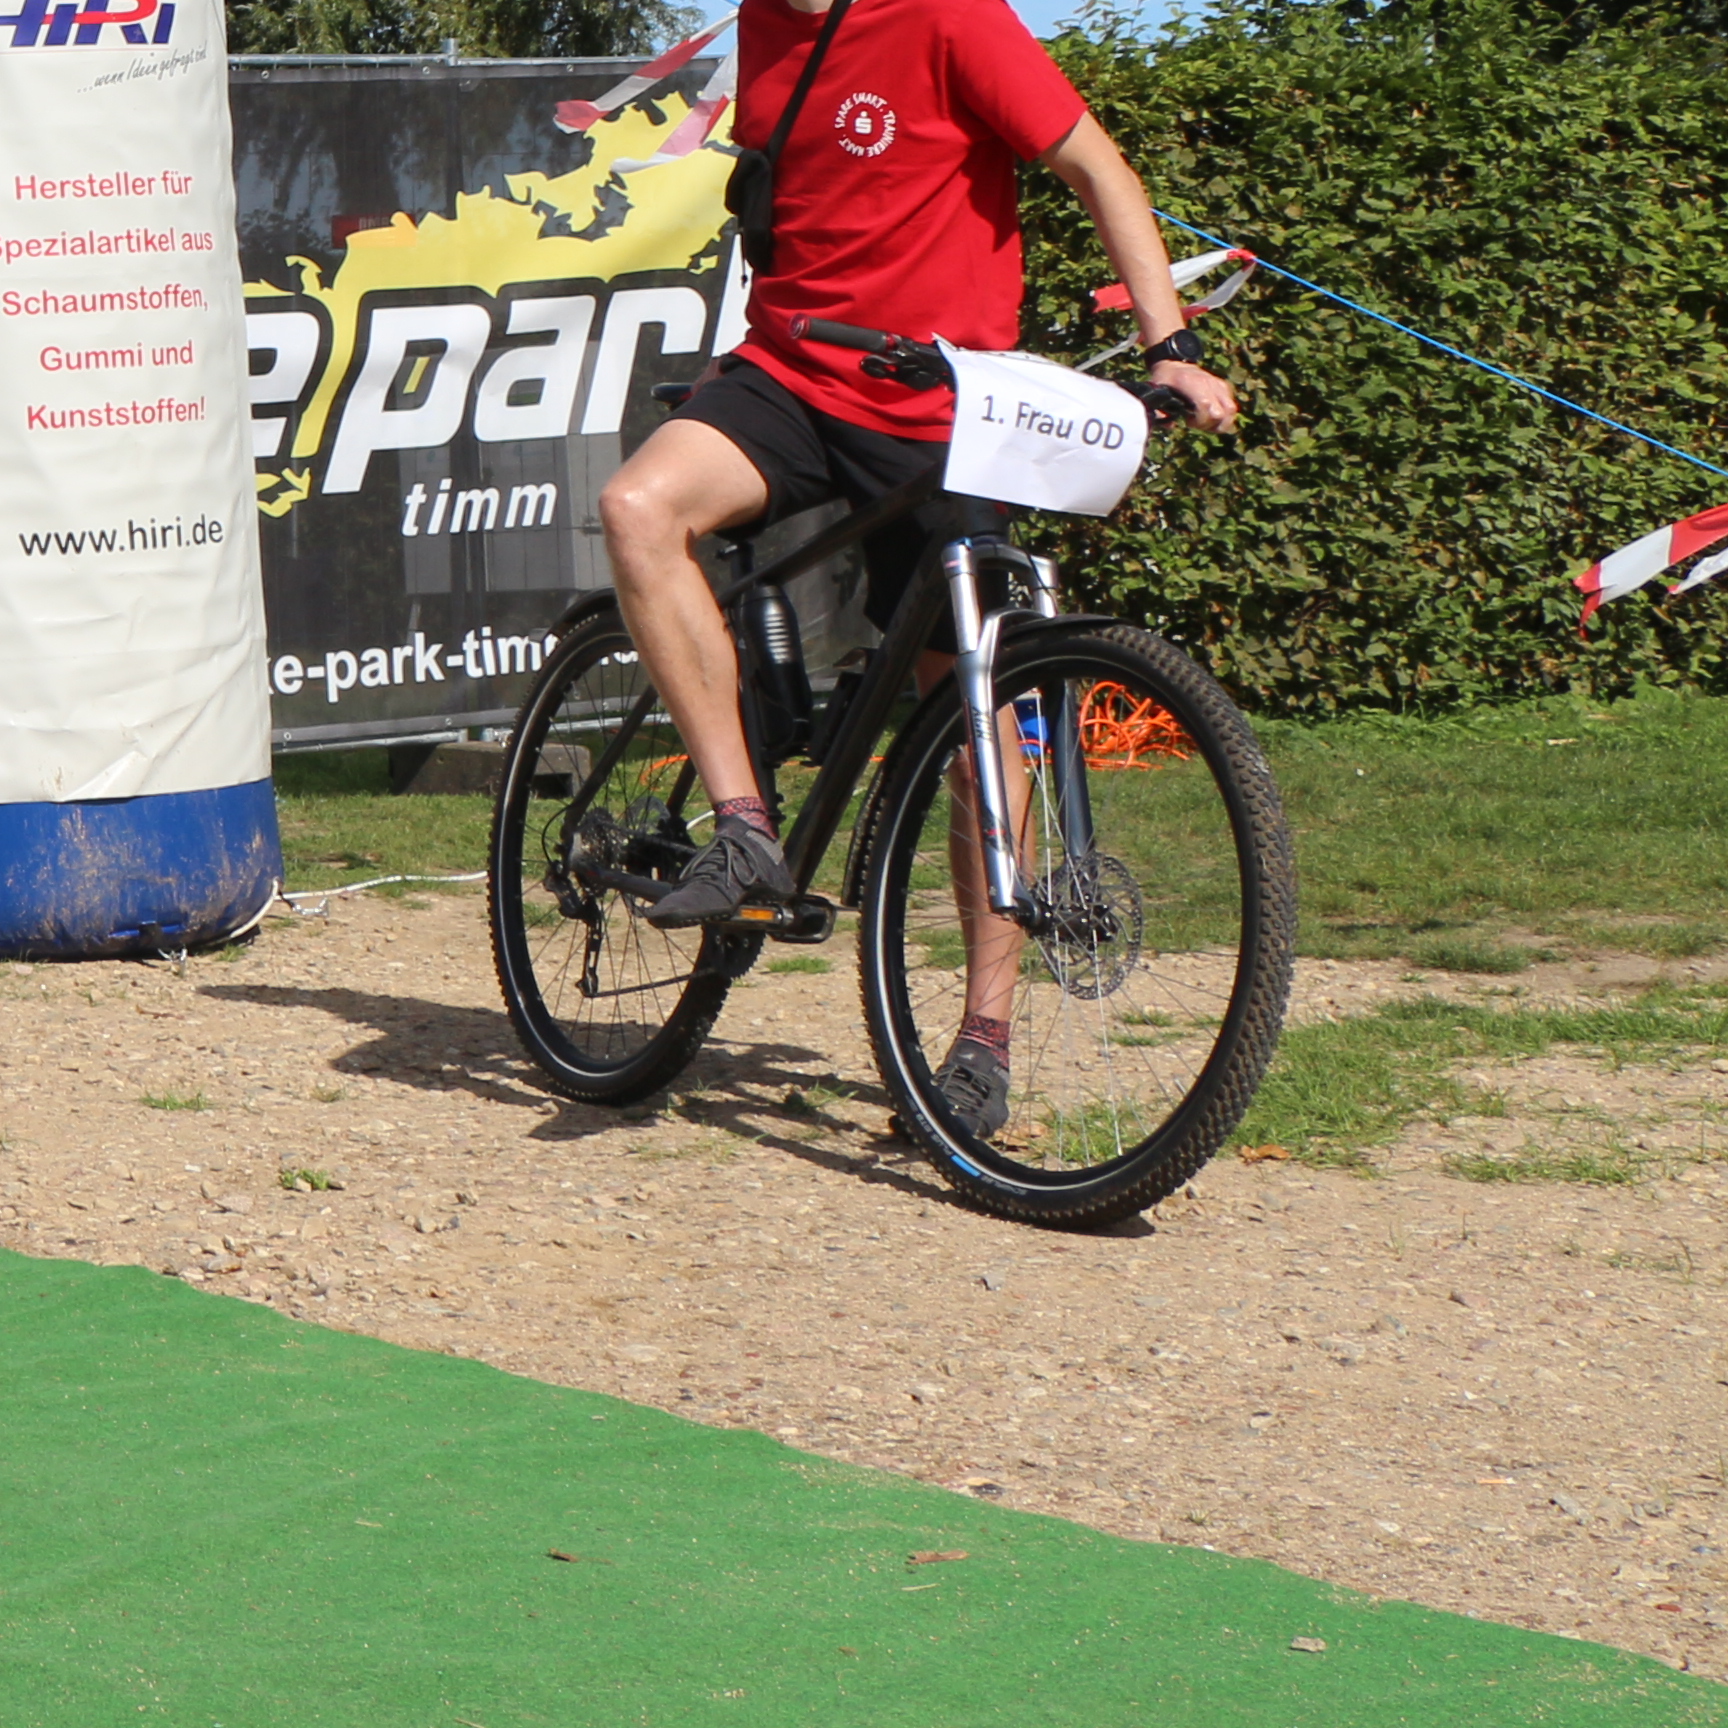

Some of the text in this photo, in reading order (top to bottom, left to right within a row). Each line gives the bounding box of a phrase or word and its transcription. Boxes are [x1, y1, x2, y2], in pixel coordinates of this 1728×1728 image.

[834, 98, 853, 129] SPARE
[866, 110, 896, 157] TRAINIERE
[14, 171, 192, 201] Hersteller für
[180, 232, 213, 253] aus
[1, 287, 209, 316] Schaumstoffen,
[39, 341, 193, 372] Gummi und
[26, 396, 206, 431] Kunststoffen!
[981, 395, 1125, 450] 1. Frau OD
[402, 477, 558, 537] timm
[19, 515, 223, 557] www.hiri.de
